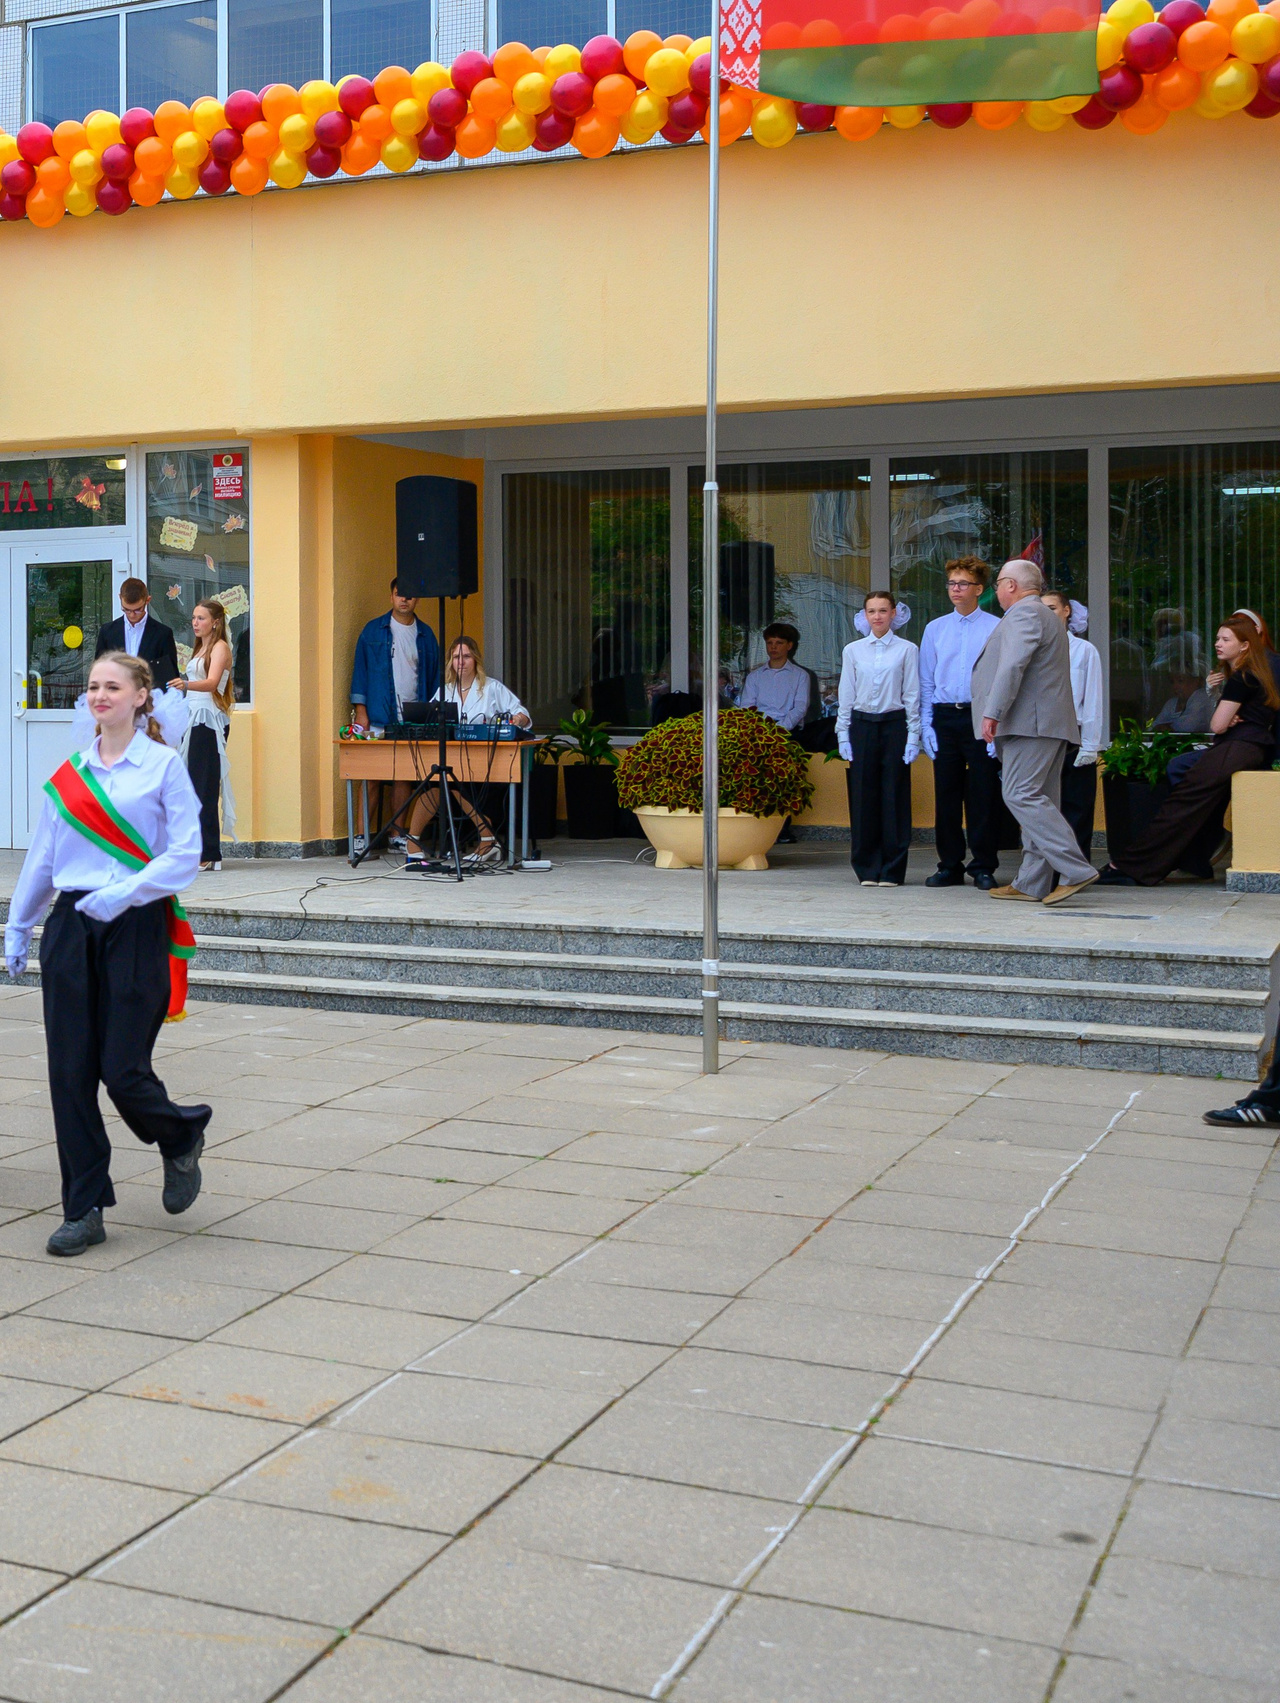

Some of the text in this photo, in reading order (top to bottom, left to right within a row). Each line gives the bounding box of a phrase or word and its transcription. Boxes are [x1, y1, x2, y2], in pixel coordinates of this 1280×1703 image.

[215, 477, 241, 486] ЗДЕСЬ
[220, 590, 236, 600] Снова
[223, 594, 241, 606] школу!
